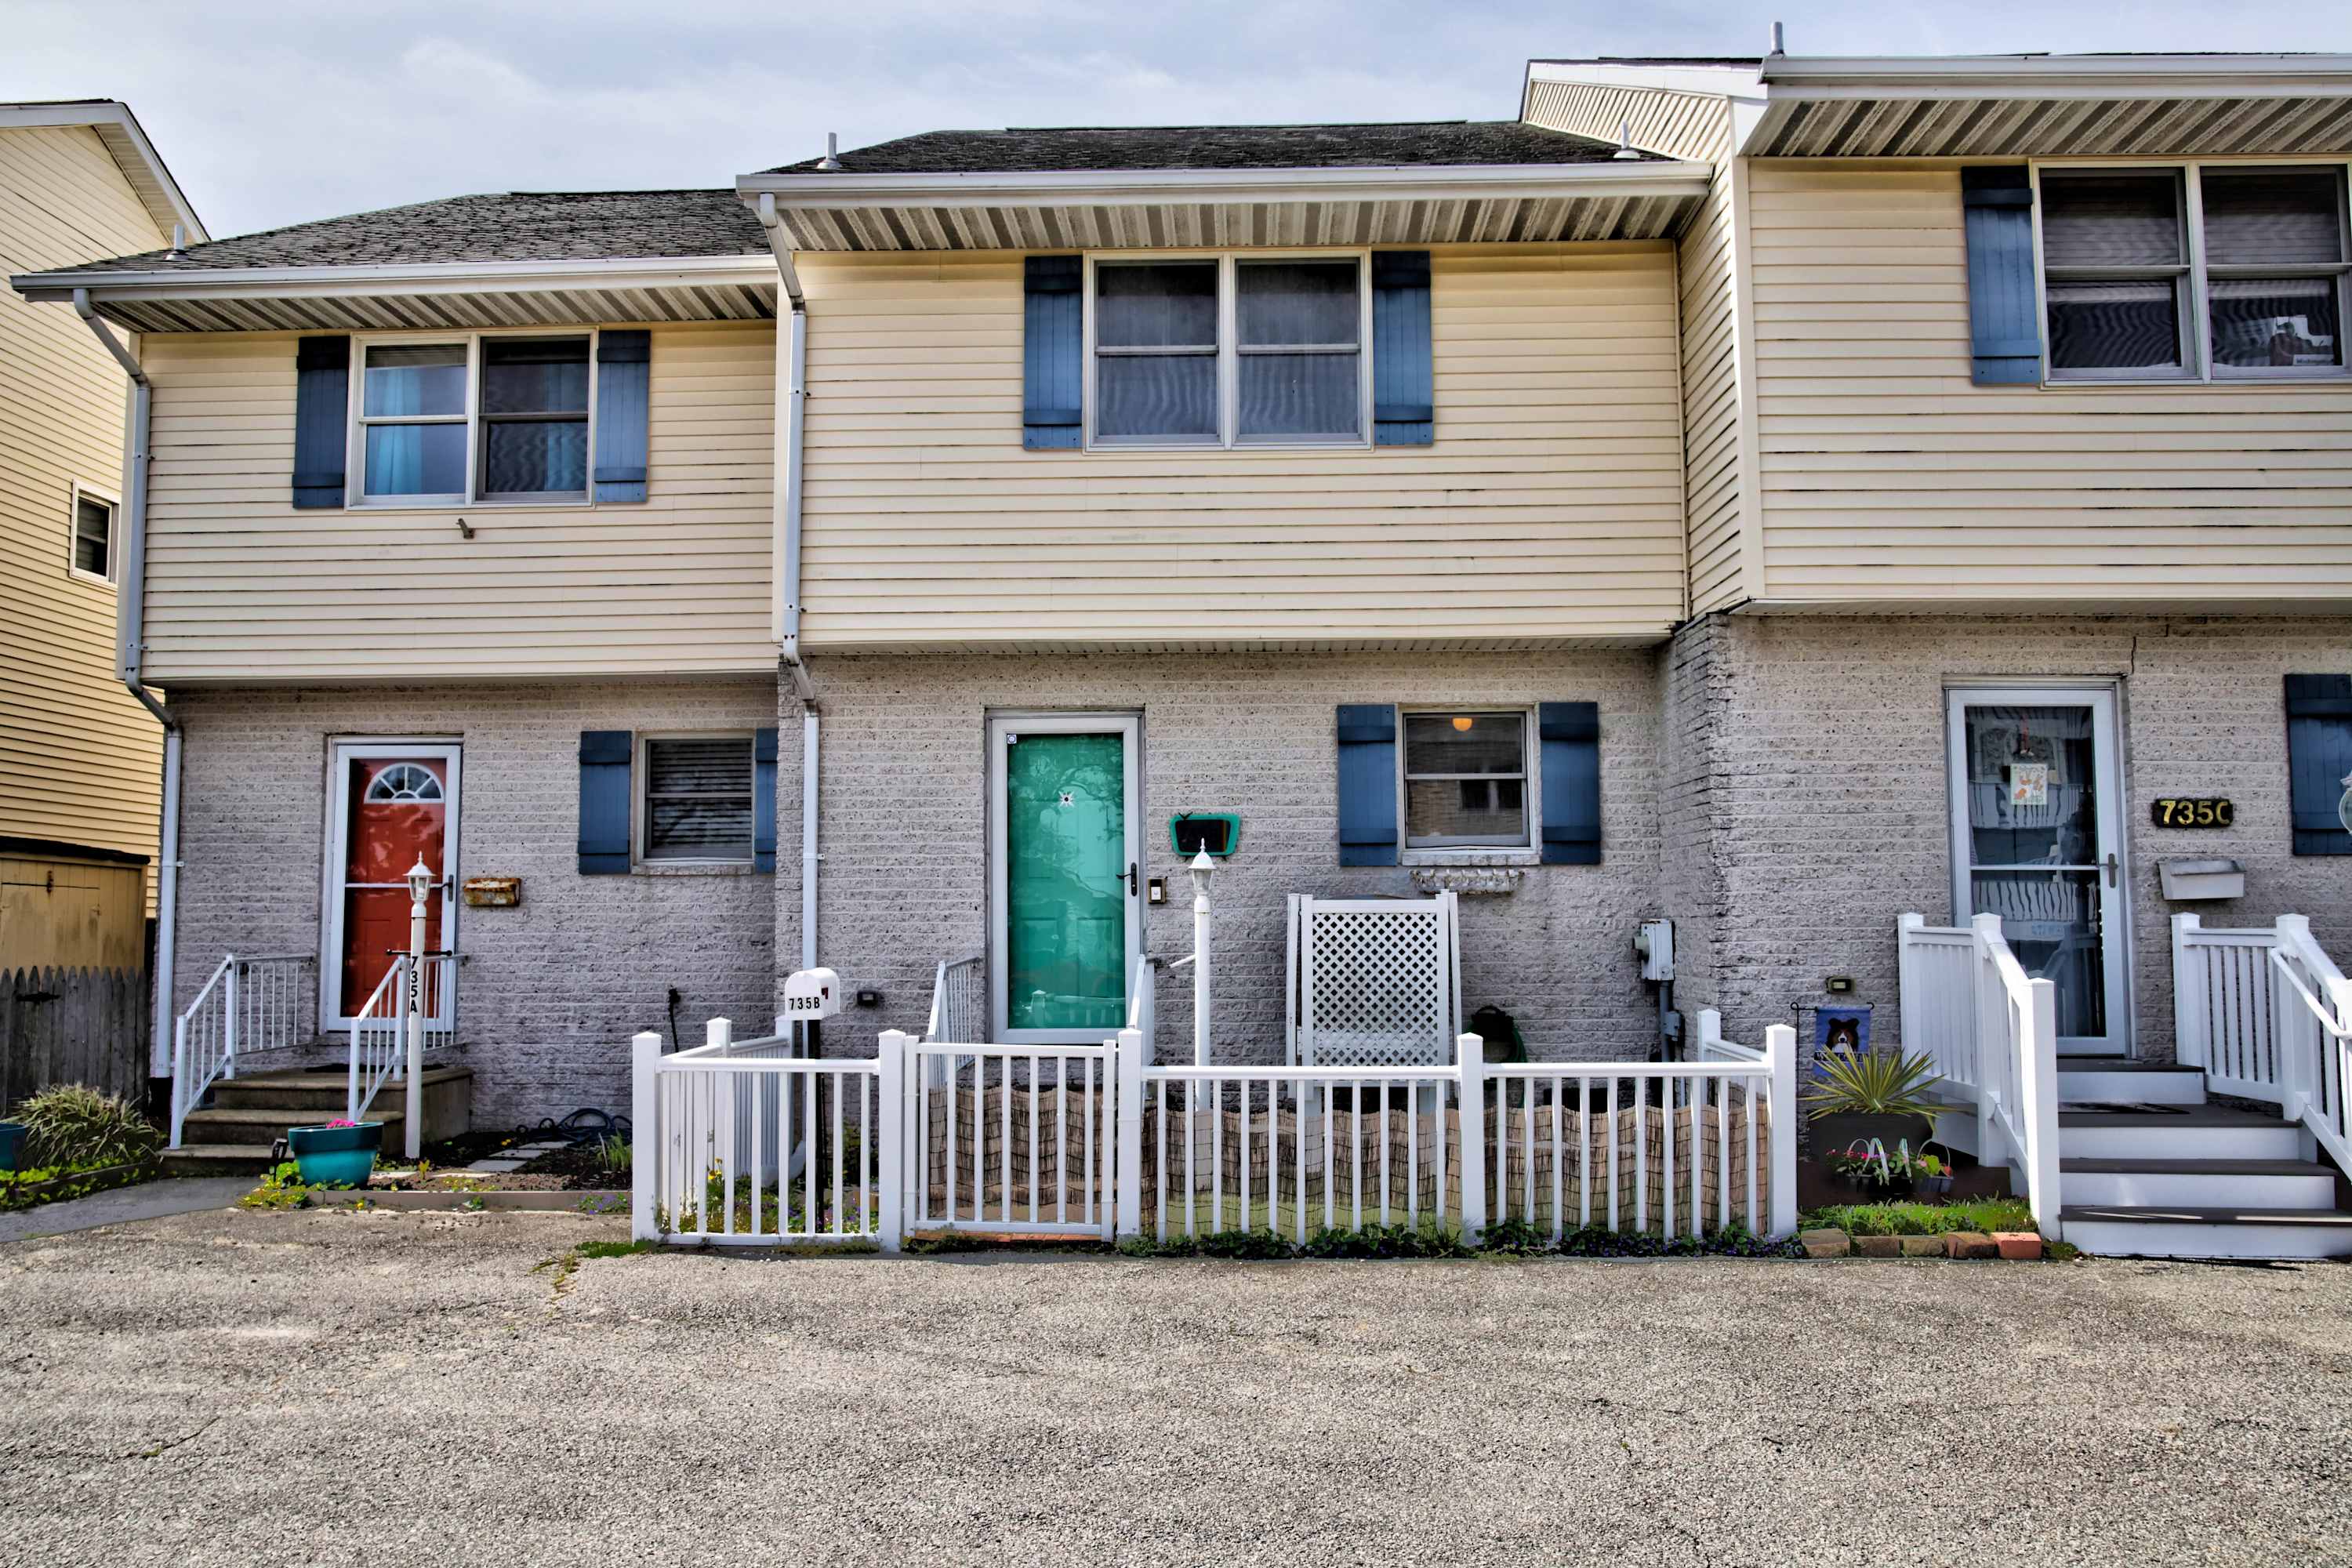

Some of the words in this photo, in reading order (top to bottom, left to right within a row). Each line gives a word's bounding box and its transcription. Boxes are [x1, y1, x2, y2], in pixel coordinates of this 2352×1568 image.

[2159, 800, 2230, 825] 735C
[410, 956, 419, 1014] 735A
[789, 996, 820, 1011] 735B
